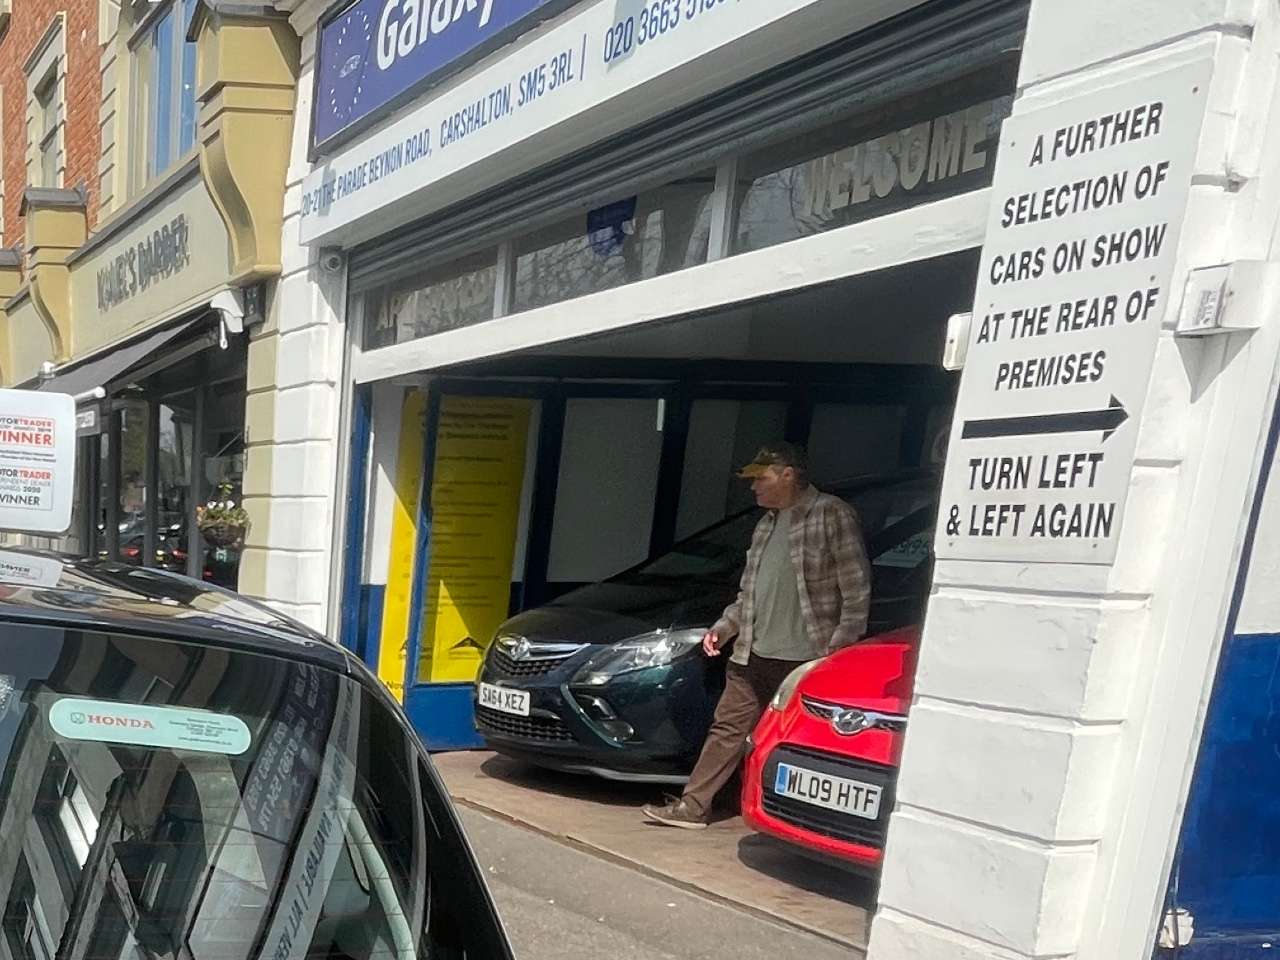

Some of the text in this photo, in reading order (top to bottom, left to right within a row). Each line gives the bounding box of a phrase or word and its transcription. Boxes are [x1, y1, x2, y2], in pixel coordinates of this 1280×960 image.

[337, 162, 367, 200] PARADE
[369, 142, 403, 185] BEYNON
[404, 128, 433, 166] ROAD,
[440, 82, 514, 148] CARSHALTON,
[518, 63, 547, 106] SM5
[549, 48, 574, 91] 3RL
[603, 16, 634, 63] 020
[638, 0, 681, 46] 3663
[1029, 102, 1163, 167] A FURTHER
[1001, 161, 1169, 228] SELECTION OF
[990, 223, 1168, 286] CARS ON SHOW
[977, 287, 1160, 344] AT THE REAR OF
[995, 351, 1106, 391] PREMISES
[969, 453, 1104, 490] TURN LEFT
[946, 503, 1116, 539] & LEFT AGAIN
[87, 714, 155, 730] HONDA
[505, 692, 524, 712] XEZ
[787, 769, 878, 813] WL09 HTF
